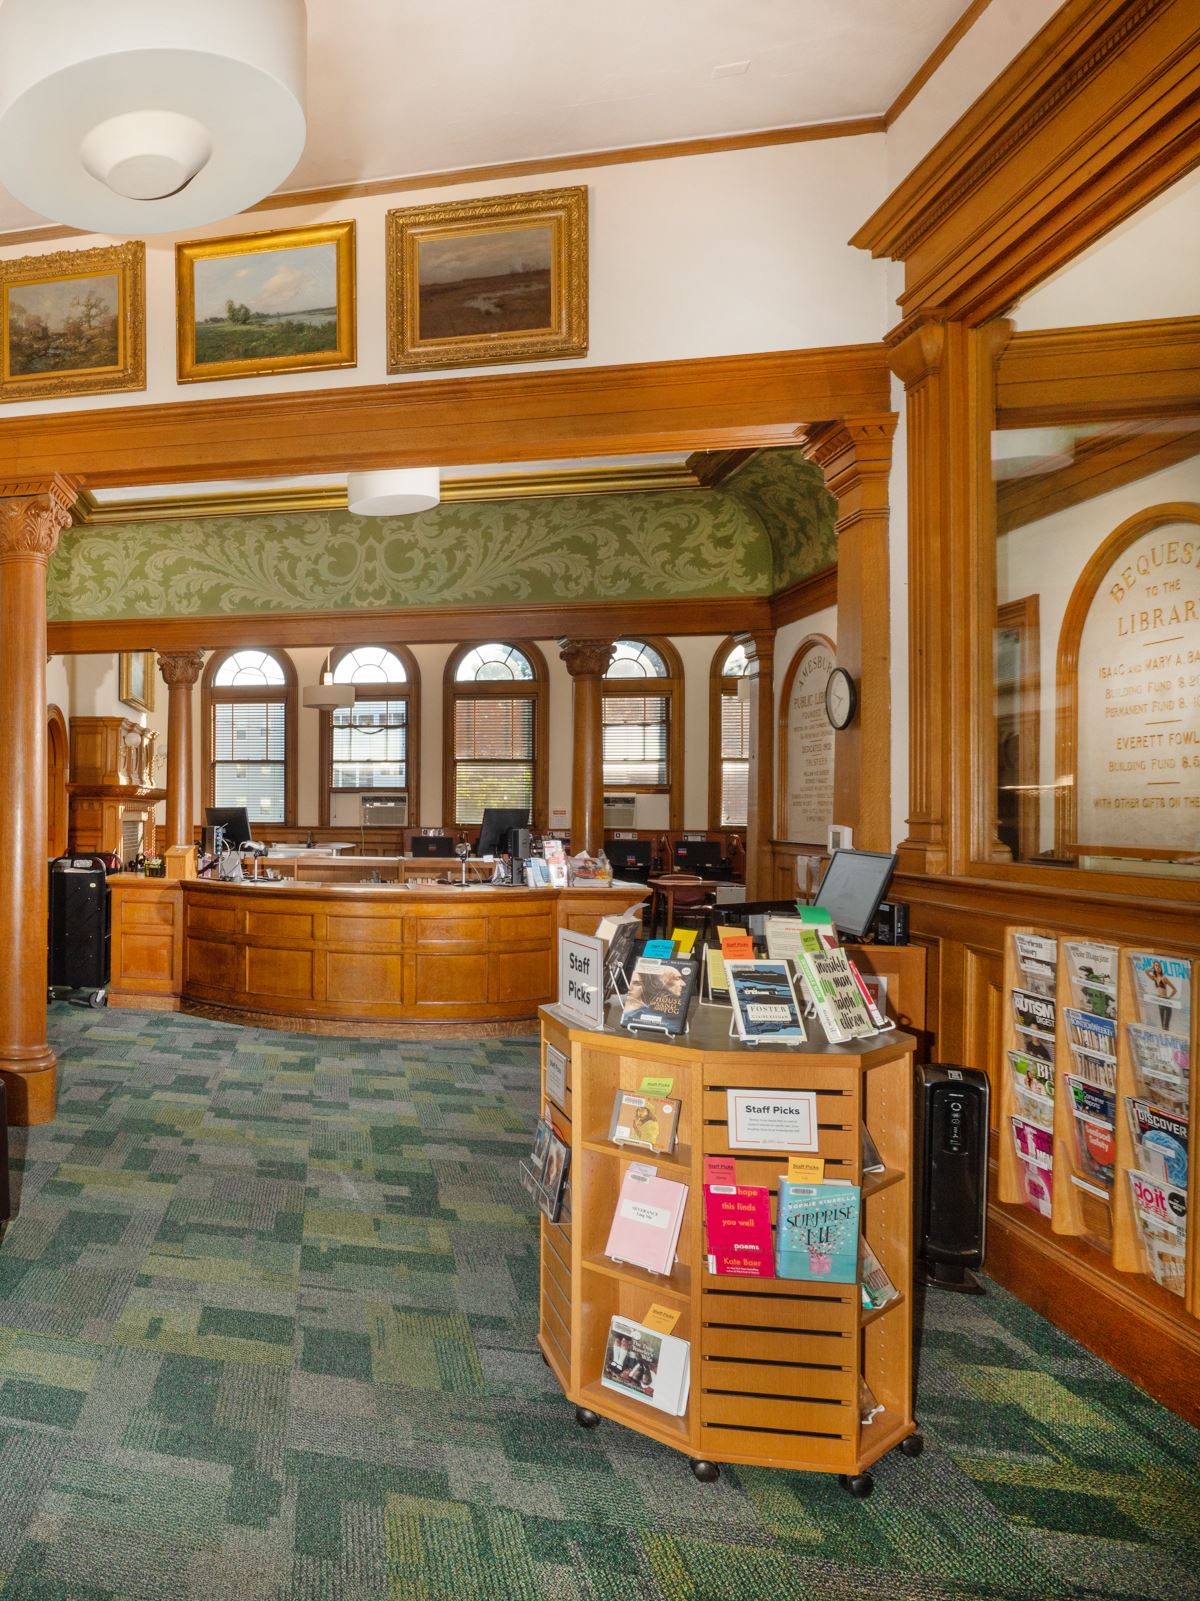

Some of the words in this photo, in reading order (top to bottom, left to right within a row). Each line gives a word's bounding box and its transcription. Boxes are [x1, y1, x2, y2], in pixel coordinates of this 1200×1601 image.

[1162, 578, 1181, 593] THE
[1118, 598, 1200, 637] LIBRAR
[1144, 654, 1172, 671] MARY
[798, 655, 834, 688] AMESBUR
[1104, 703, 1149, 719] PERMANENT
[1116, 734, 1164, 750] EVERETT
[1151, 758, 1176, 770] FUND
[1114, 797, 1139, 809] OTHER
[1142, 796, 1165, 809] GIFTS
[569, 952, 591, 975] Staff
[814, 955, 849, 975] invisible
[832, 975, 853, 989] man
[568, 979, 591, 1005] Picks
[750, 1005, 788, 1014] FOSTER
[745, 1105, 771, 1114] Staff
[773, 1106, 801, 1115] Picks
[1138, 1109, 1188, 1138] DISCOVER
[737, 1188, 758, 1197] hope
[722, 1203, 736, 1211] this
[737, 1203, 756, 1212] finds
[722, 1219, 737, 1227] you
[739, 1219, 755, 1227] well
[786, 1205, 856, 1230] SURPRISE
[804, 1224, 837, 1247] ME
[734, 1244, 760, 1252] poems
[723, 1257, 741, 1266] Kate
[743, 1258, 762, 1267] Baer
